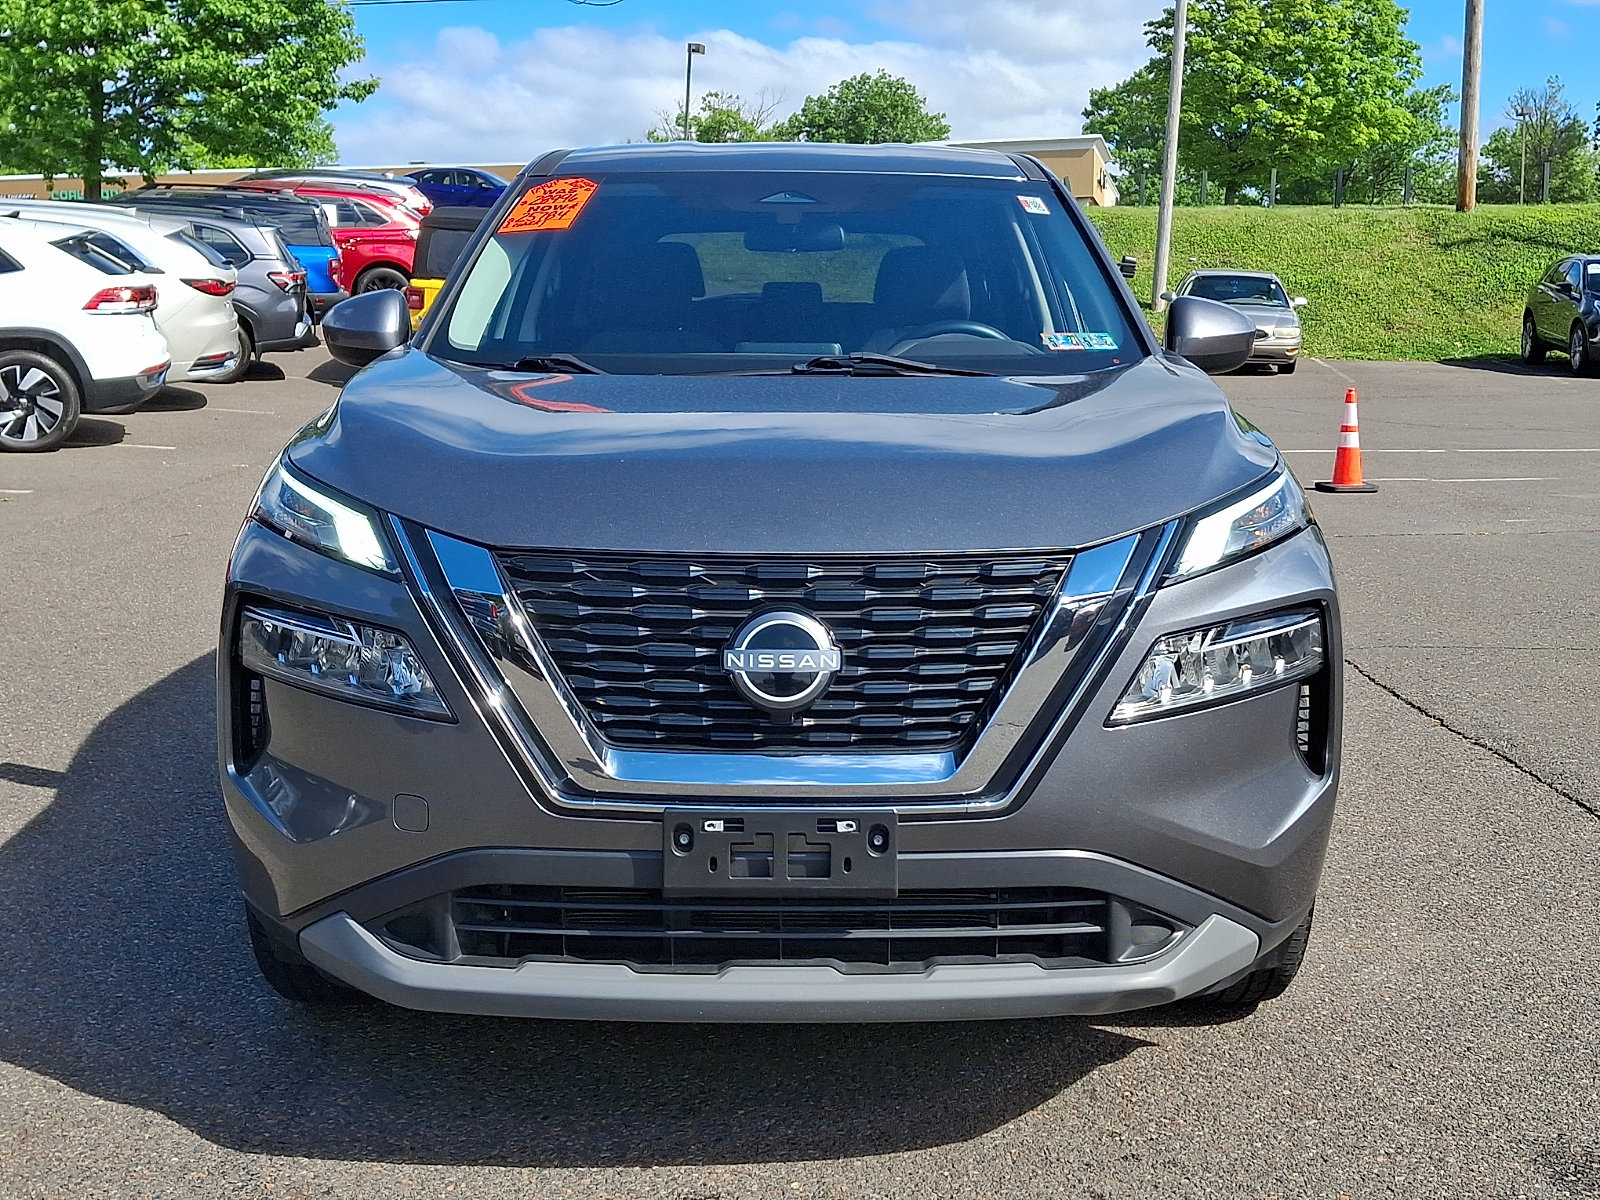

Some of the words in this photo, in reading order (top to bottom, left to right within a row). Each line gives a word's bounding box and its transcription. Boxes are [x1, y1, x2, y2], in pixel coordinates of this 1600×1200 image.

[542, 187, 578, 195] WAS
[527, 204, 569, 213] NOW
[726, 652, 838, 668] NISSAN
